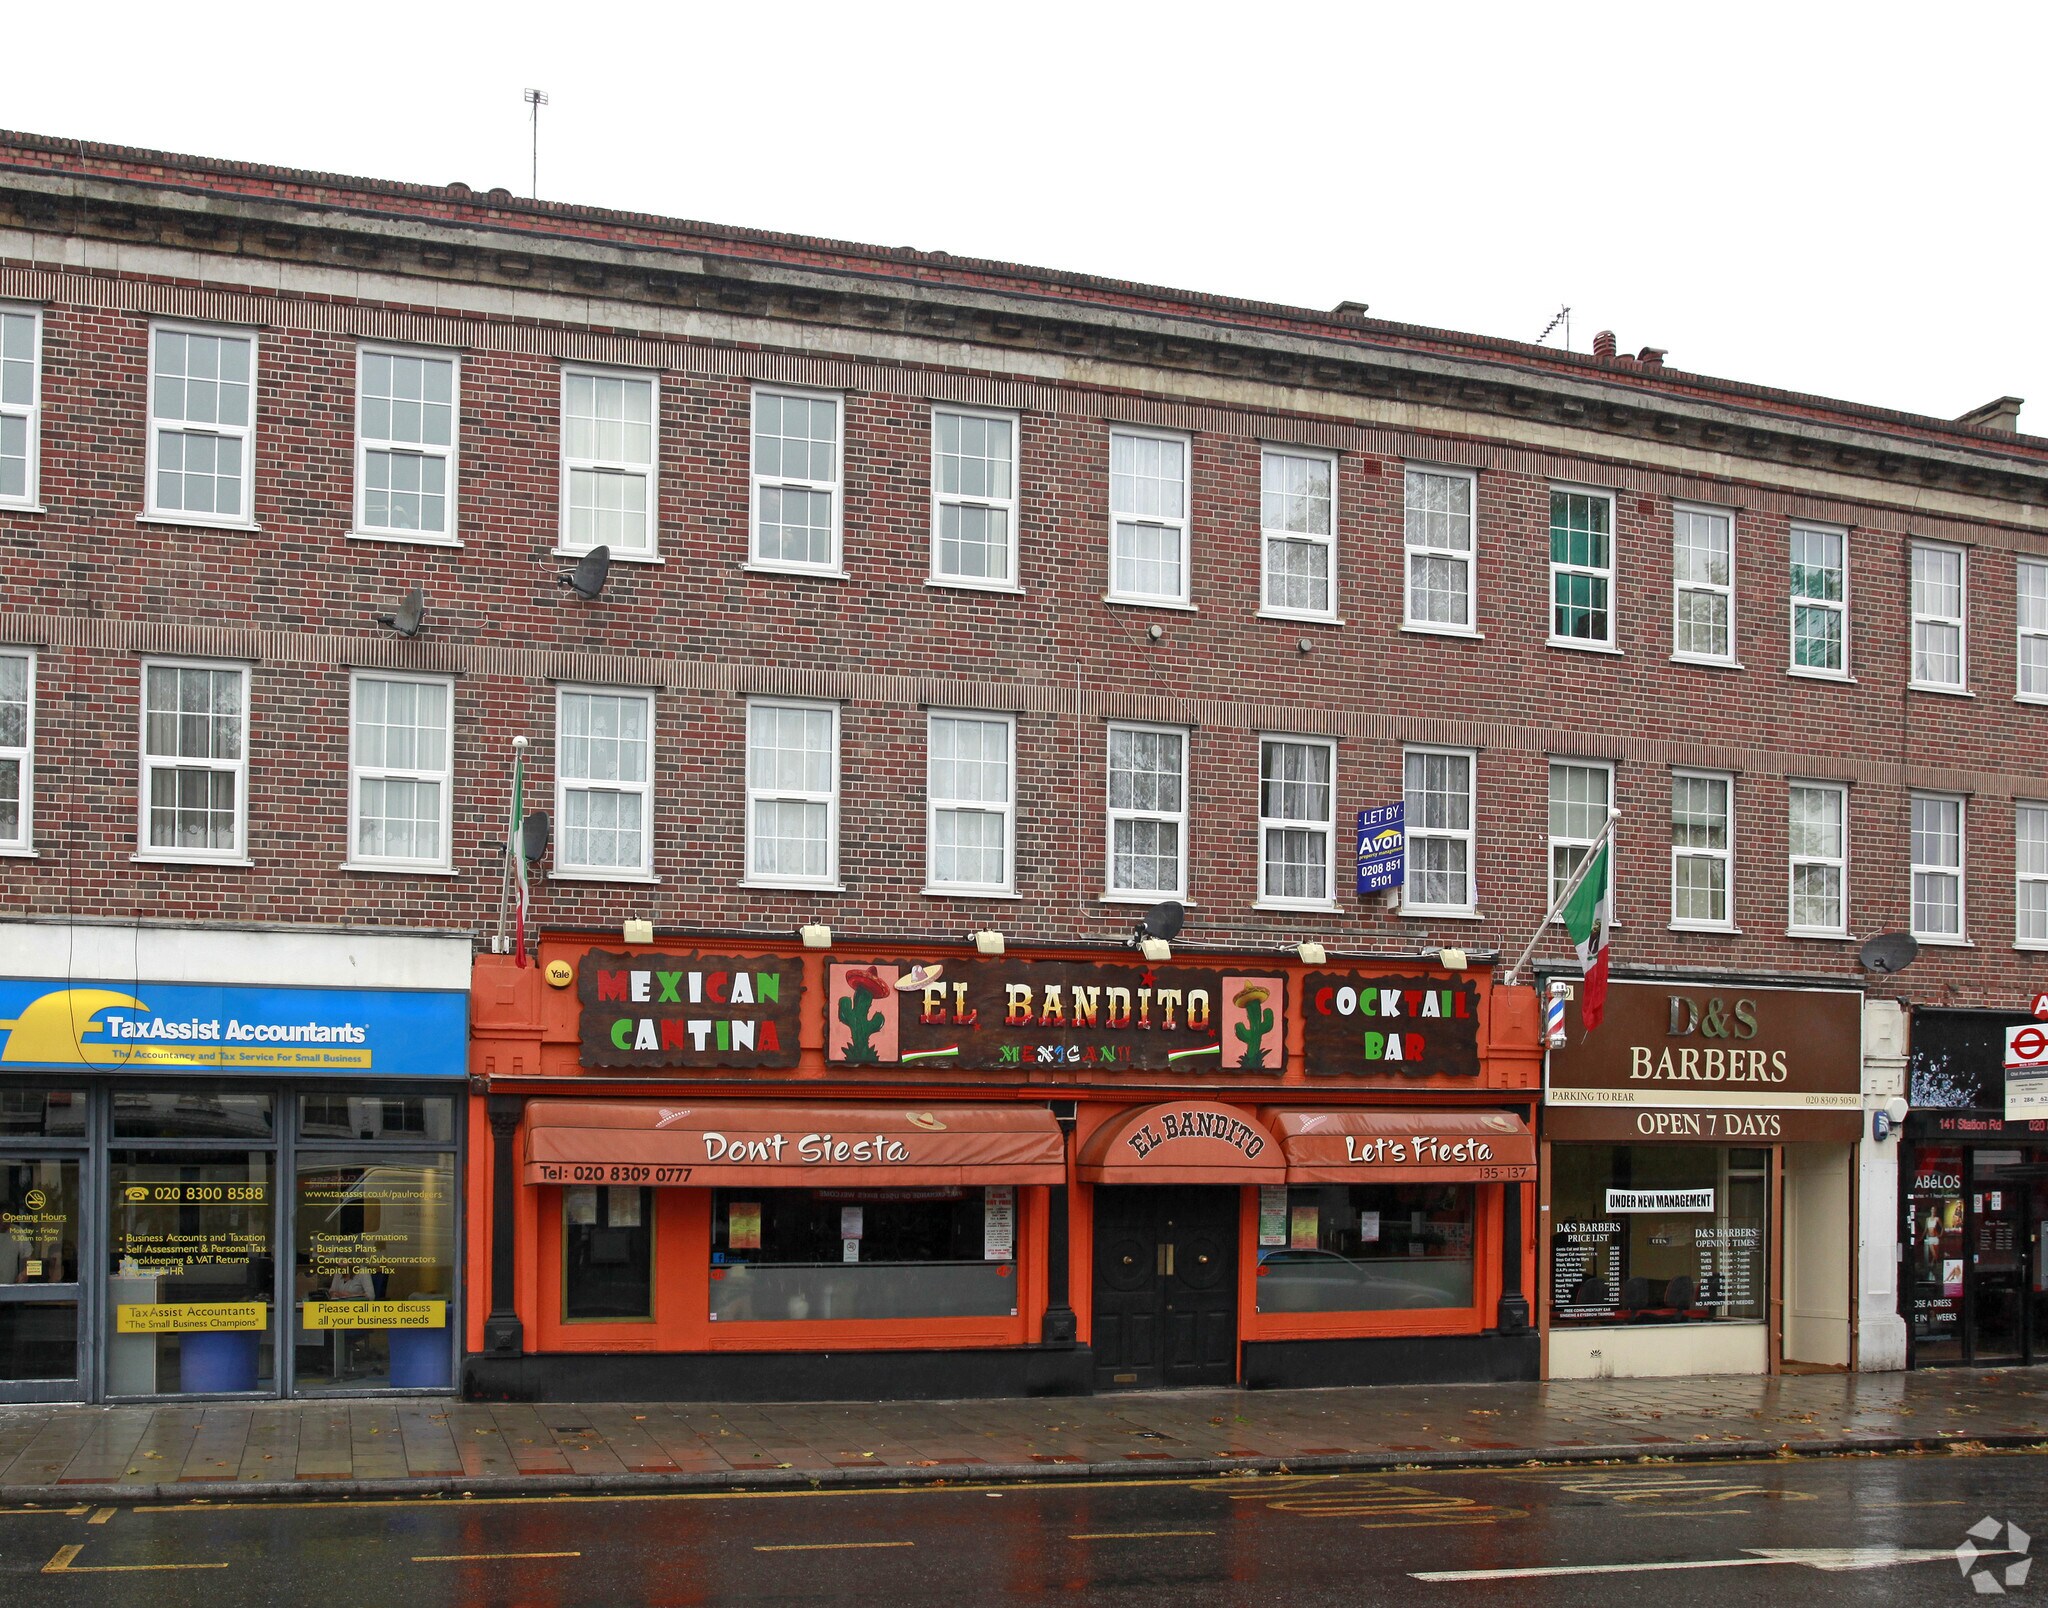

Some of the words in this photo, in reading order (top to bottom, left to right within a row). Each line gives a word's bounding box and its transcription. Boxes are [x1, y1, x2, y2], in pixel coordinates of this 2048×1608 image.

[1364, 809, 1384, 825] LET
[1386, 805, 1399, 820] BY
[1359, 833, 1402, 855] Avon
[1359, 852, 1378, 860] property
[1379, 846, 1403, 855] management
[1361, 863, 1383, 877] 0208
[1385, 859, 1400, 872] 851
[1370, 874, 1392, 888] 5101
[551, 970, 570, 979] Yale
[597, 970, 780, 1004] MEXICAN
[920, 981, 977, 1025] EL
[1005, 983, 1211, 1031] BANDITO
[1315, 987, 1470, 1019] COCKTAIL
[1666, 995, 1758, 1039] D&S
[107, 1016, 220, 1040] TaxAssist
[225, 1020, 365, 1044] Accountants
[610, 1018, 781, 1052] CANTINA
[1365, 1032, 1425, 1062] BAR
[113, 1050, 130, 1058] The
[134, 1050, 195, 1062] Accountancy
[199, 1052, 215, 1060] and
[219, 1052, 236, 1061] Tax
[240, 1053, 274, 1061] Service
[277, 1053, 292, 1062] For
[295, 1054, 320, 1062] Small
[323, 1054, 361, 1063] Business
[1629, 1046, 1788, 1083] BARBERS
[1552, 1091, 1594, 1101] PARKING
[1597, 1092, 1609, 1101] TO
[1611, 1092, 1635, 1102] REAR
[1805, 1095, 1819, 1104] 020
[1820, 1096, 1838, 1105] 8309
[1840, 1096, 1857, 1105] 5050
[1636, 1112, 1700, 1136] OPEN
[1706, 1114, 1717, 1136] 7
[1724, 1113, 1781, 1137] DAYS
[1940, 1119, 1955, 1130] 141
[1958, 1118, 1987, 1130] Station
[1989, 1119, 2002, 1130] Rd
[2029, 1120, 2045, 1131] 020
[1127, 1125, 1163, 1160] EL
[1161, 1111, 1266, 1159] BANDITO
[702, 1132, 789, 1162] Don't
[798, 1133, 910, 1163] Siesta
[1345, 1136, 1407, 1163] Let's
[1411, 1136, 1493, 1163] Fiesta
[540, 1165, 568, 1180] Tel:
[574, 1166, 604, 1180] 020
[610, 1167, 650, 1181] 8309
[656, 1168, 692, 1182] 0777
[1915, 1174, 1960, 1188] ABéLOS
[155, 1187, 181, 1200] 020
[186, 1187, 222, 1200] 8300
[227, 1187, 264, 1200] 8588
[305, 1189, 442, 1200] www.taxassist.co.uk/paulrodgers
[1609, 1194, 1636, 1208] UNDER
[1637, 1194, 1655, 1208] NEW
[1655, 1193, 1711, 1208] MANAGEMENT
[2, 1212, 38, 1223] Opening
[41, 1212, 67, 1221] Hours
[10, 1228, 34, 1236] Monday
[1556, 1223, 1577, 1233] D&S
[1579, 1222, 1621, 1233] BARBERS
[1695, 1228, 1714, 1238] D&S
[1717, 1228, 1756, 1238] BARBERS
[126, 1234, 163, 1242] Business
[166, 1233, 207, 1242] Accounts
[210, 1233, 226, 1242] and
[228, 1233, 266, 1242] Taxation
[317, 1233, 358, 1243] Company
[361, 1233, 408, 1241] Formations
[1567, 1234, 1591, 1243] PRICE
[1592, 1233, 1610, 1242] LIST
[1732, 1239, 1755, 1247] TIMES
[126, 1245, 143, 1254] Self
[145, 1245, 198, 1254] Assessment
[201, 1245, 207, 1253] &
[211, 1244, 248, 1253] Personal
[250, 1244, 266, 1253] Tax
[317, 1244, 352, 1253] Business
[355, 1244, 377, 1253] Plans
[187, 1256, 193, 1264] &
[196, 1256, 213, 1264] VAT
[216, 1255, 249, 1264] Returns
[317, 1255, 436, 1264] Contractors/Subcontractors
[170, 1267, 184, 1275] HR
[317, 1266, 349, 1276] Capital
[352, 1266, 377, 1274] Gains
[380, 1266, 395, 1274] Tax
[318, 1303, 350, 1313] Please
[352, 1303, 369, 1313] call
[372, 1303, 380, 1313] in
[383, 1304, 394, 1313] to
[397, 1303, 431, 1313] discuss
[1933, 1299, 1952, 1307] DRESS
[129, 1307, 183, 1317] TaxAssist
[187, 1307, 255, 1317] Accountants
[1936, 1313, 1957, 1321] WEEKS
[148, 1319, 170, 1328] Small
[173, 1319, 208, 1328] Business
[318, 1316, 329, 1325] all
[332, 1317, 354, 1327] your
[357, 1315, 397, 1325] business
[400, 1315, 429, 1324] needs
